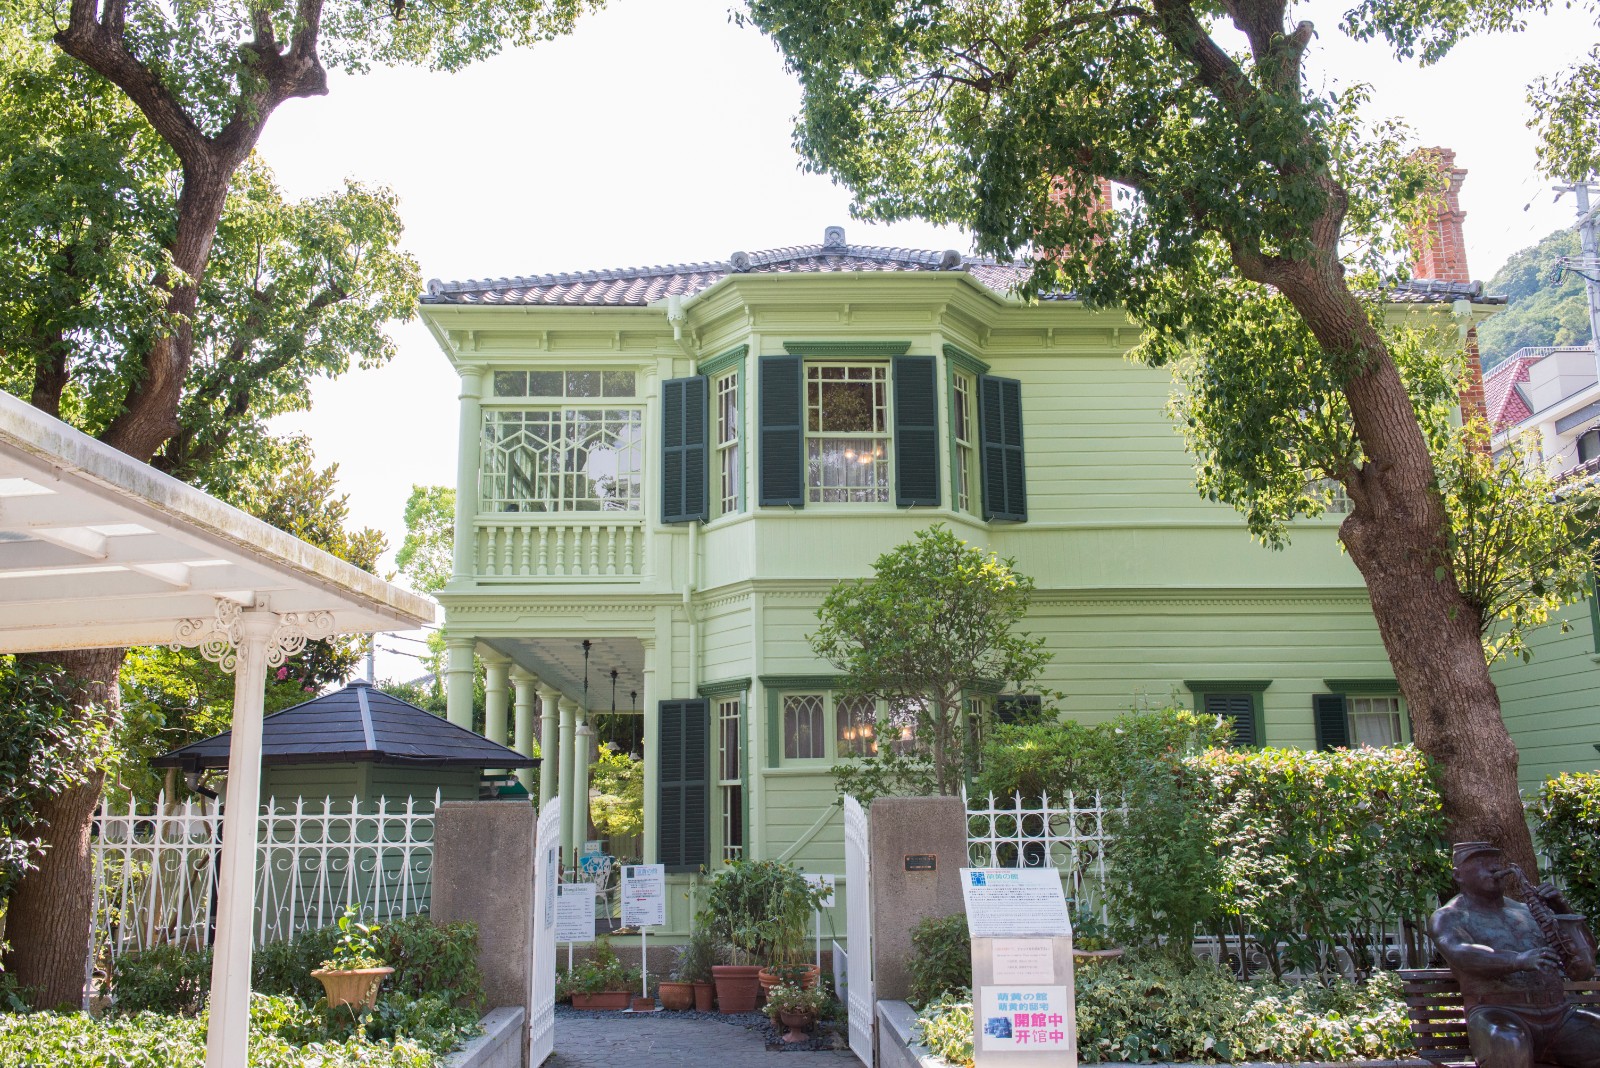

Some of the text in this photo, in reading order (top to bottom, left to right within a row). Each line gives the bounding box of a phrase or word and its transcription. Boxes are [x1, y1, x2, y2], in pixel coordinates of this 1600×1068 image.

[1014, 1013, 1063, 1027] 開館中
[1015, 1029, 1064, 1044] 开馆中
